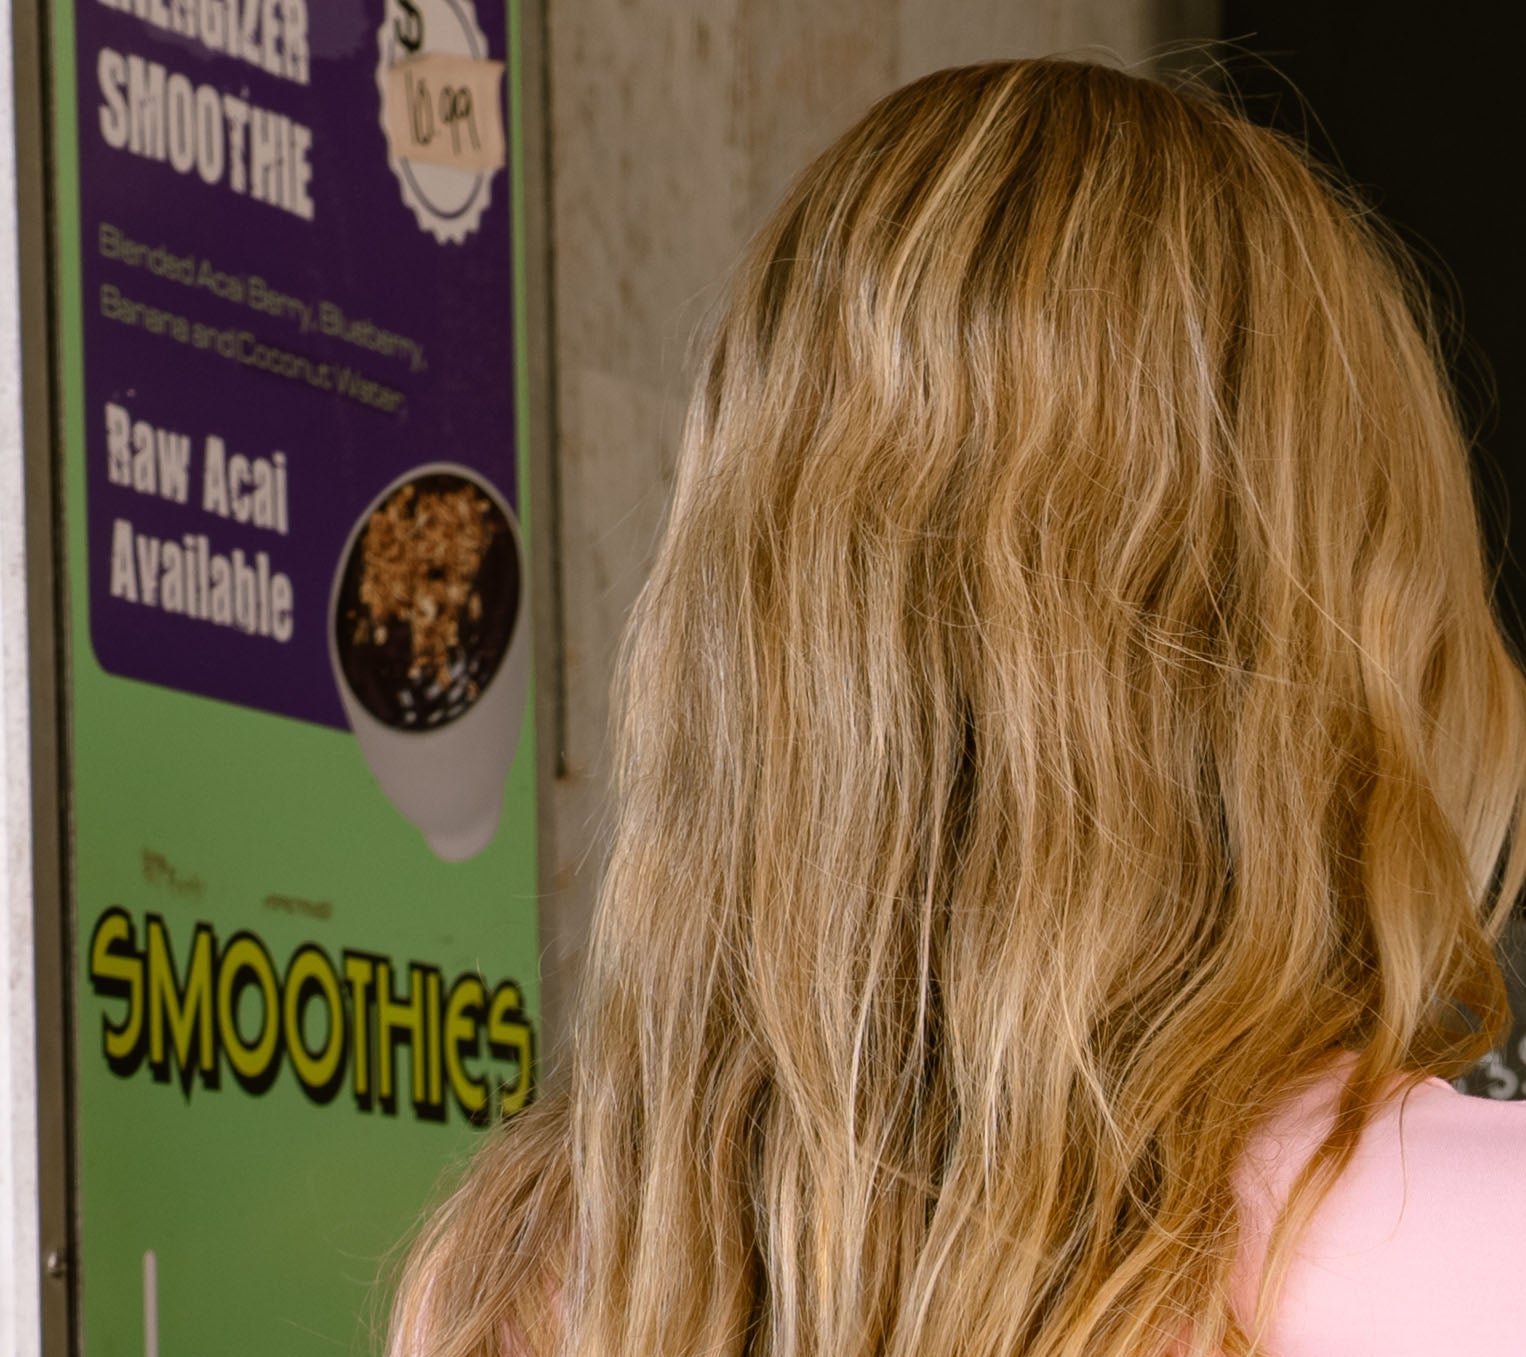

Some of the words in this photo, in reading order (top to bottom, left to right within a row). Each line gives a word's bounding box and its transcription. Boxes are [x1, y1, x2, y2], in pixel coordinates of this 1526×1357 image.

[98, 46, 315, 222] SMOOTHIE
[99, 221, 196, 285] Blended
[100, 283, 190, 344] Banana
[105, 401, 192, 505] Raw
[203, 433, 289, 536] Acai
[110, 517, 294, 643] Available
[89, 905, 537, 1130] SMOOTHIES
